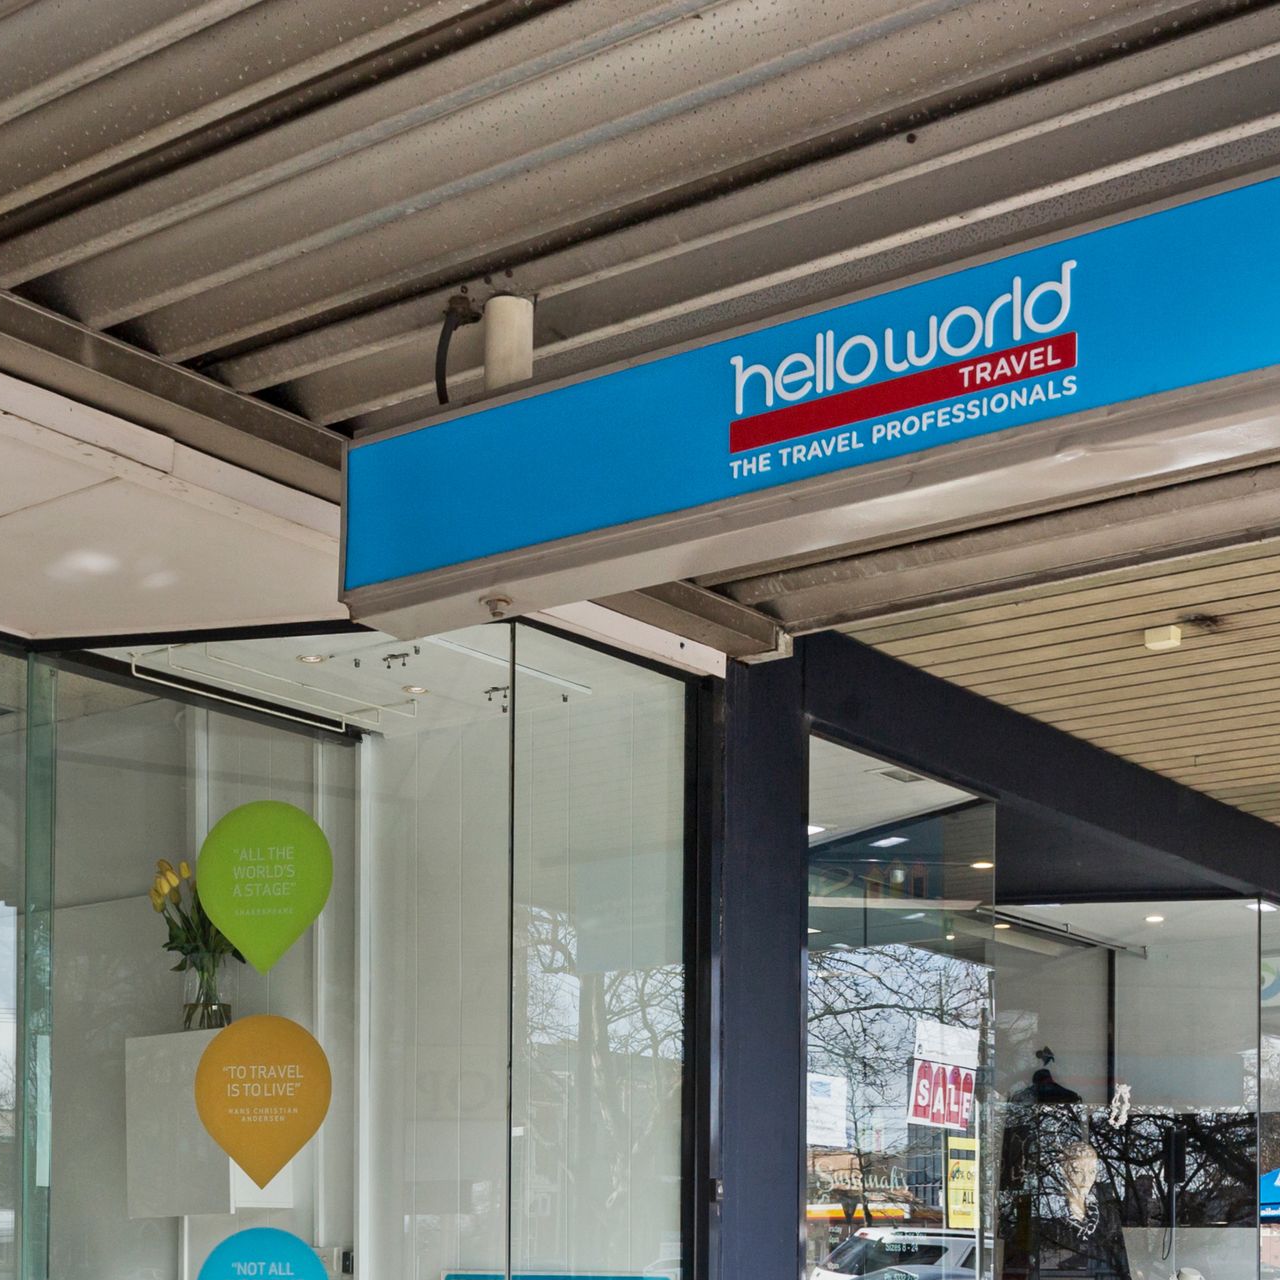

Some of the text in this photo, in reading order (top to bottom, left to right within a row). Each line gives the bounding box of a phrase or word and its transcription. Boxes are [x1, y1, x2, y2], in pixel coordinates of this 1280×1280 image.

[959, 345, 1061, 388] TRAVEL
[729, 375, 1077, 479] THE TRAVEL PROFESSIONALS
[267, 846, 294, 860] THE
[232, 864, 295, 879] WORLD'S
[232, 884, 242, 897] A
[249, 1064, 304, 1079] TRAVEL
[227, 1083, 240, 1097] IS
[242, 1083, 261, 1097] TO
[917, 1078, 972, 1120] SALE
[253, 1107, 298, 1115] CHRISTIAN
[268, 1261, 294, 1276] ALL
